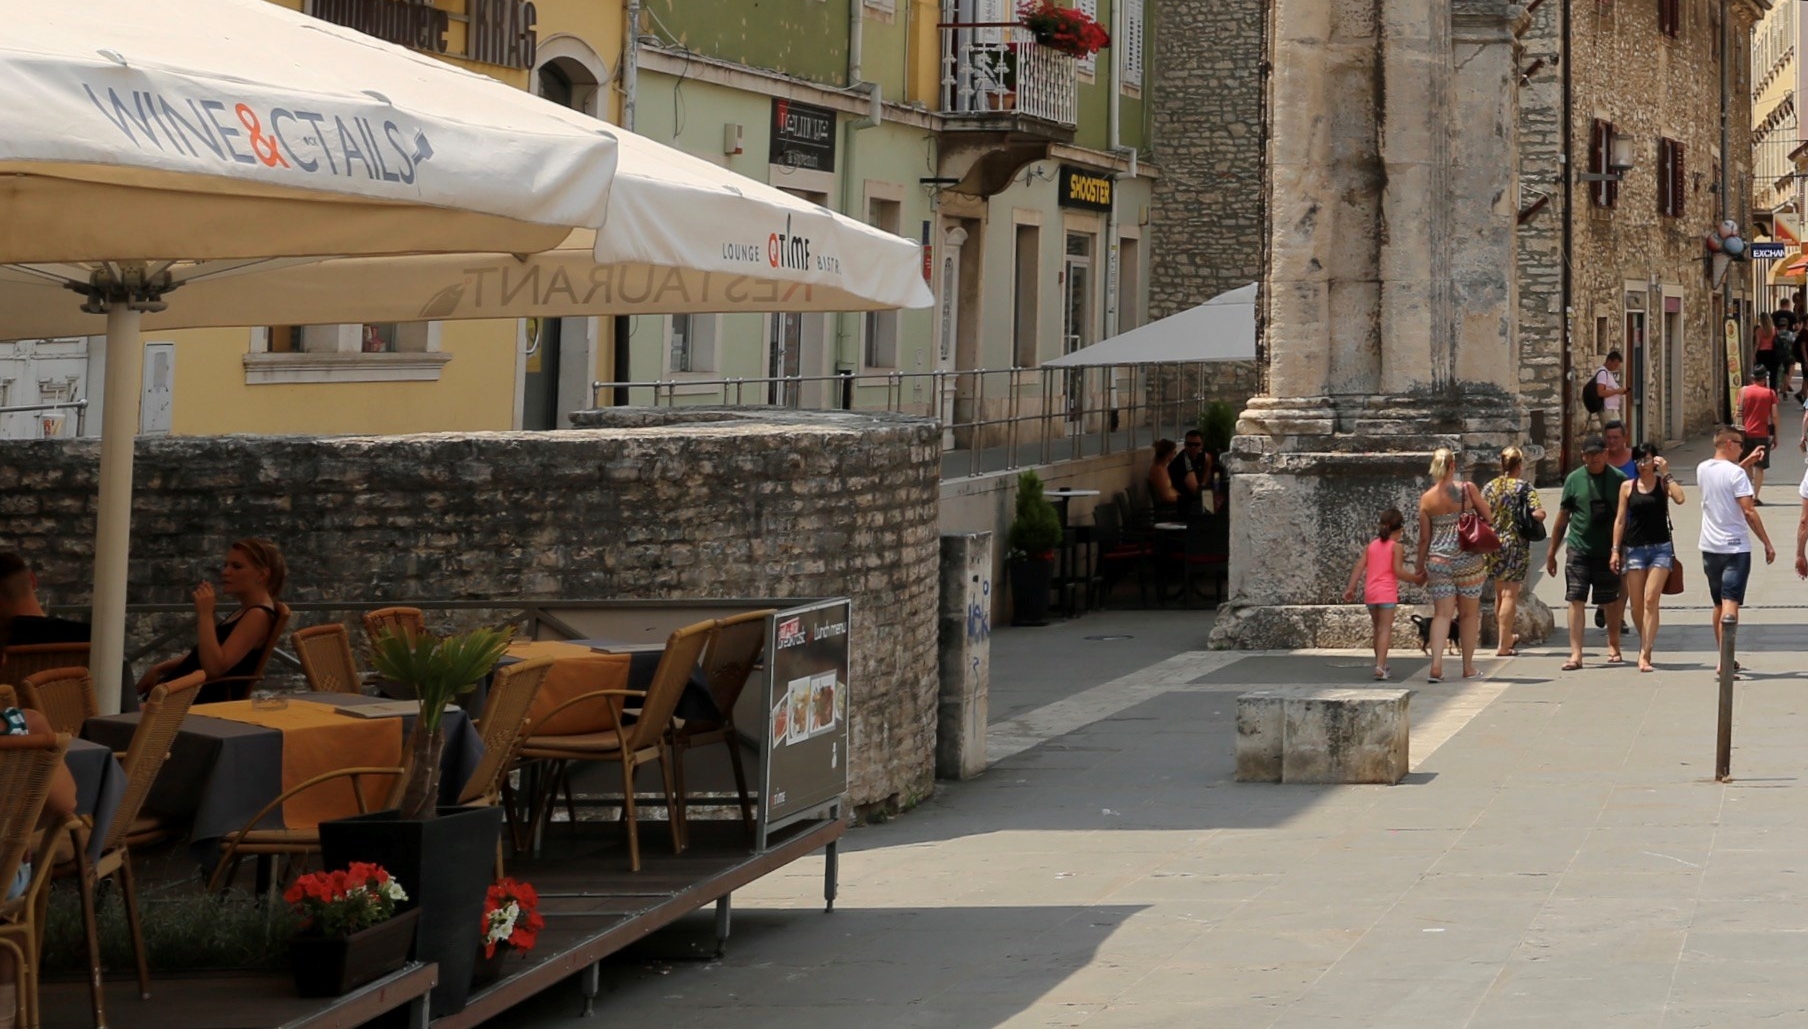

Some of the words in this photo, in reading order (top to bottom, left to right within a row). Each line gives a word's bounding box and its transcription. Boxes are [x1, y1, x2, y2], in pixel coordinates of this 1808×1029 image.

[1070, 174, 1110, 204] SHOOSTER
[722, 243, 760, 262] LOUNGE
[817, 255, 842, 275] BISTR
